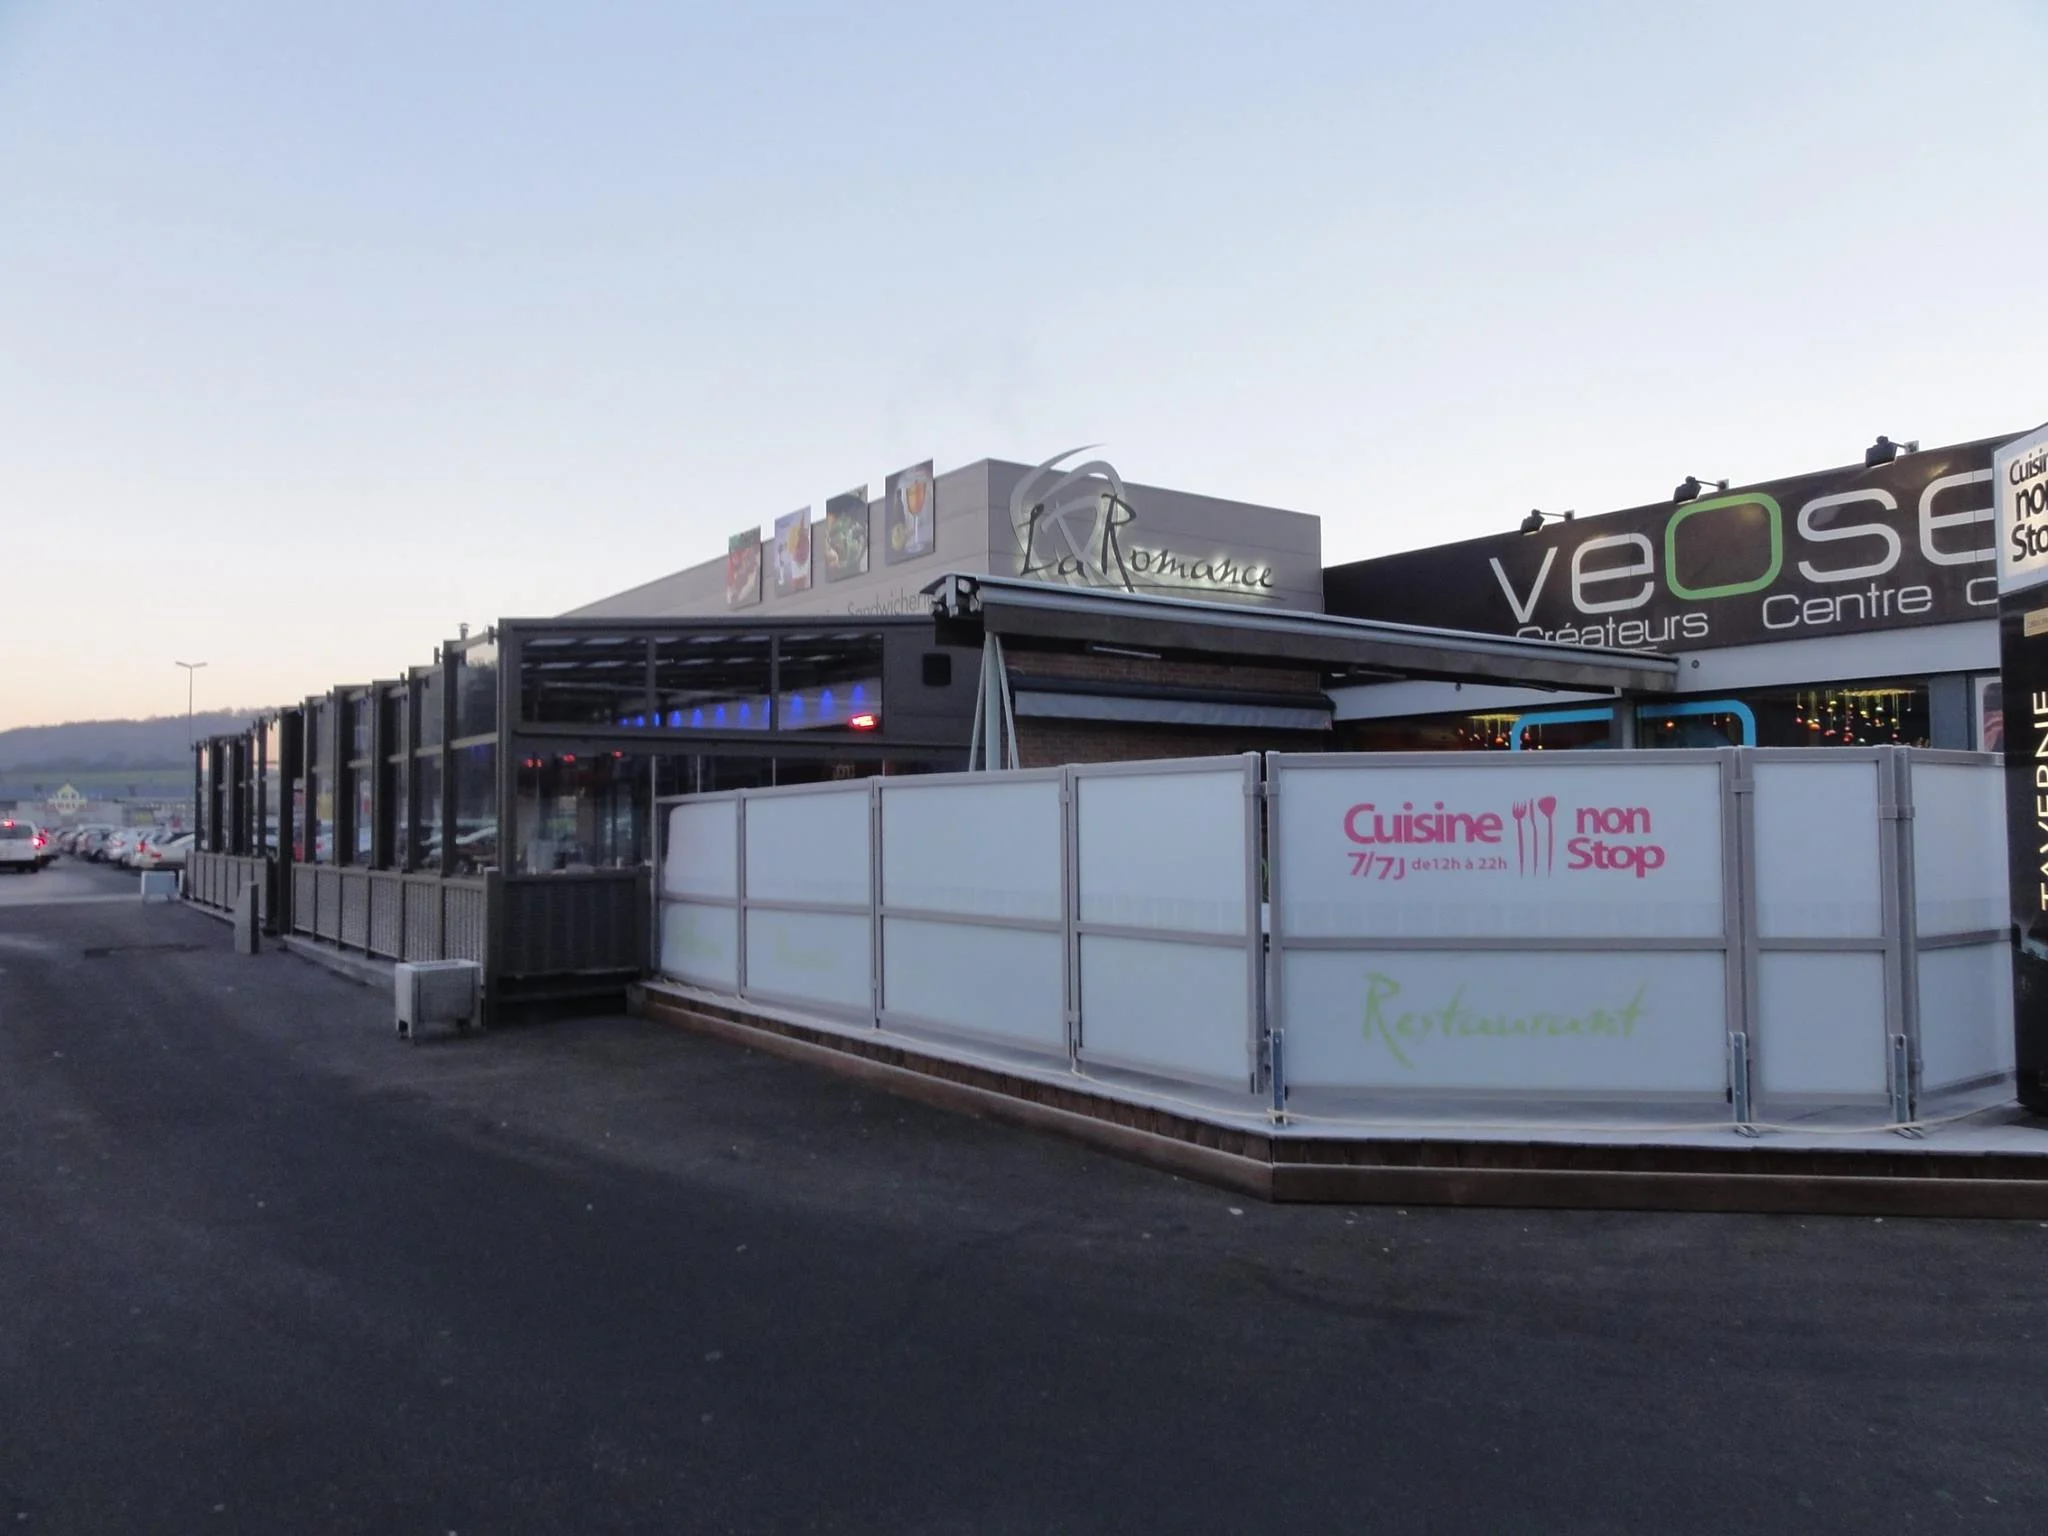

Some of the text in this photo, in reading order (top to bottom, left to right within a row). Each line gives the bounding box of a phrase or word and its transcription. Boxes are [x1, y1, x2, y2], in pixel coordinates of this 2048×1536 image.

[2016, 480, 2048, 521] no
[1018, 493, 1274, 593] La Romance
[1762, 583, 1932, 629] Centre
[1344, 801, 1504, 844] Cuisine
[1576, 806, 1651, 834] non
[1465, 857, 1474, 870] à
[1479, 857, 1508, 870] 22h
[1567, 837, 1665, 879] Stop
